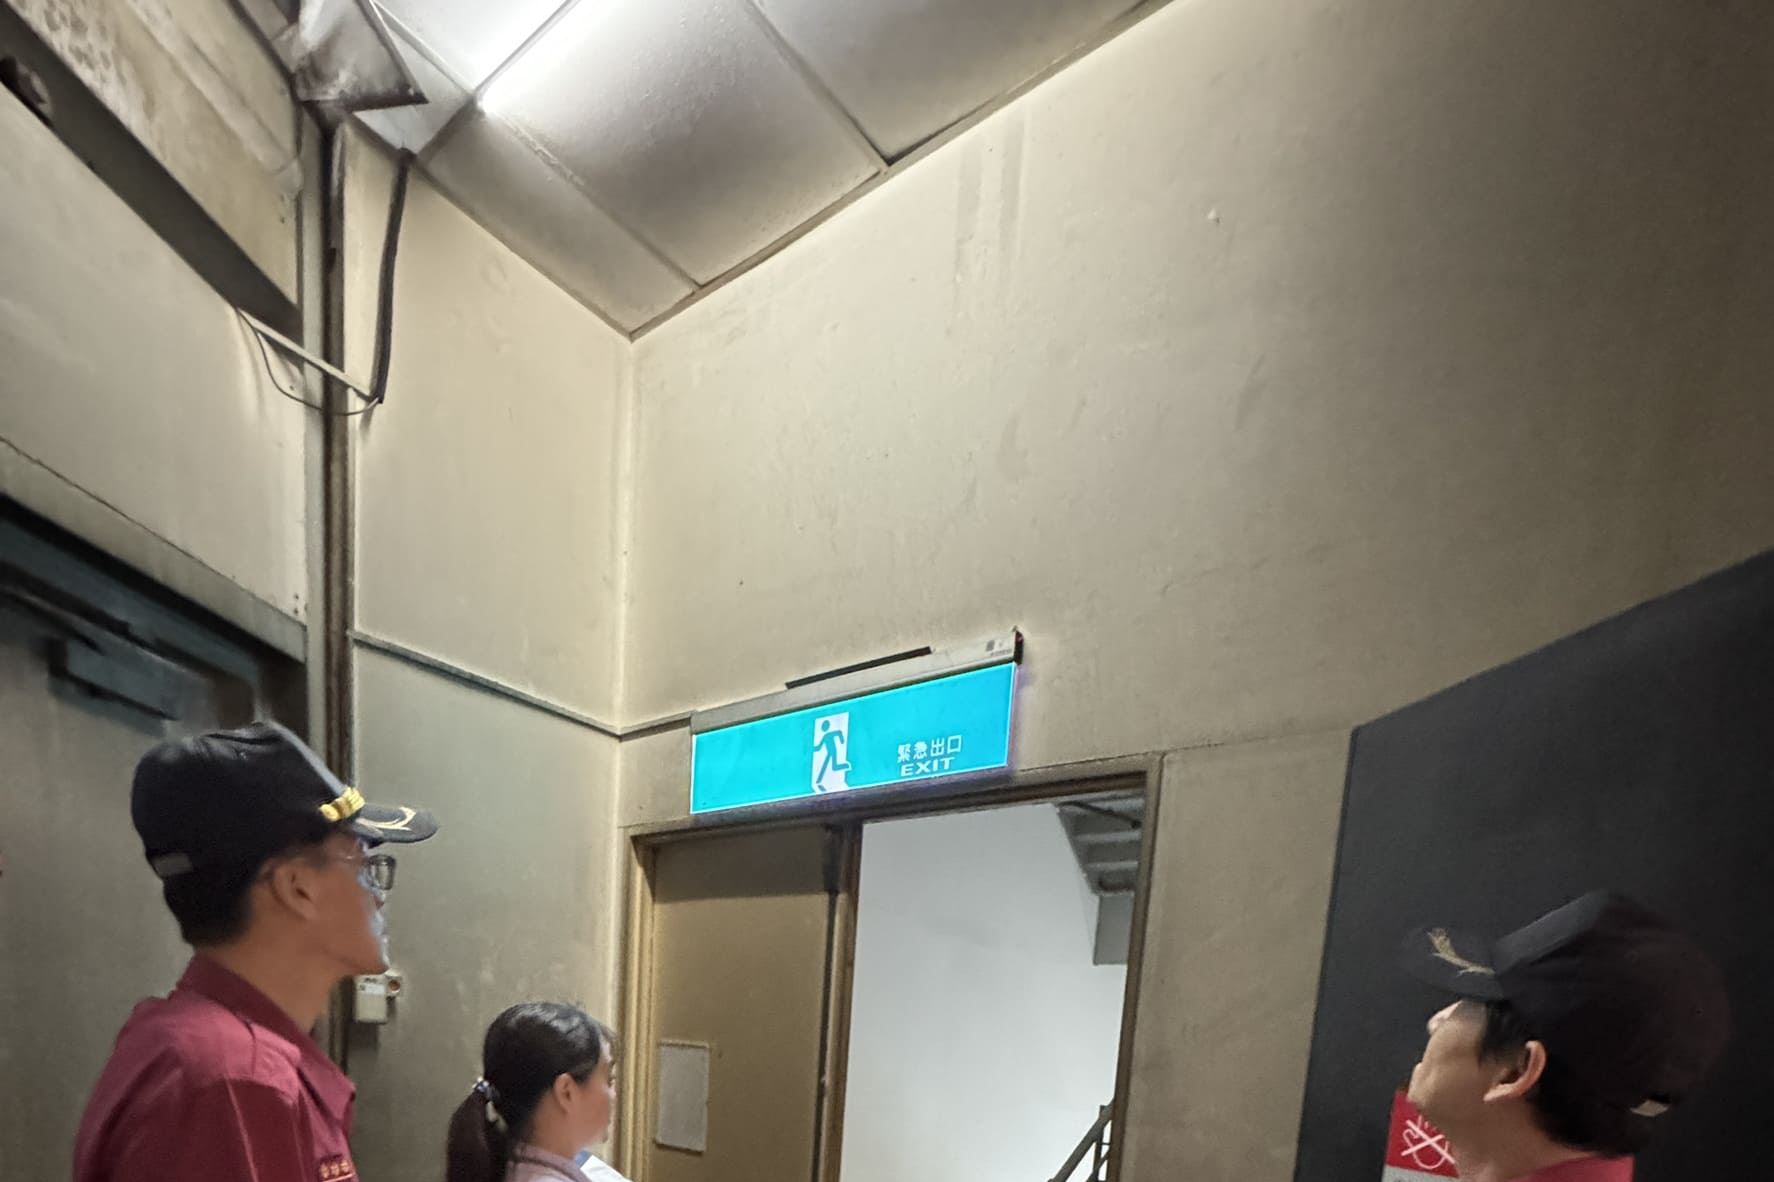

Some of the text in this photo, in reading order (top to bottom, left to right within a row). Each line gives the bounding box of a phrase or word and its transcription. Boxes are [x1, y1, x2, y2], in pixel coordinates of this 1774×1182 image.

[898, 734, 962, 762] 緊急出口
[900, 757, 955, 777] EXIT
